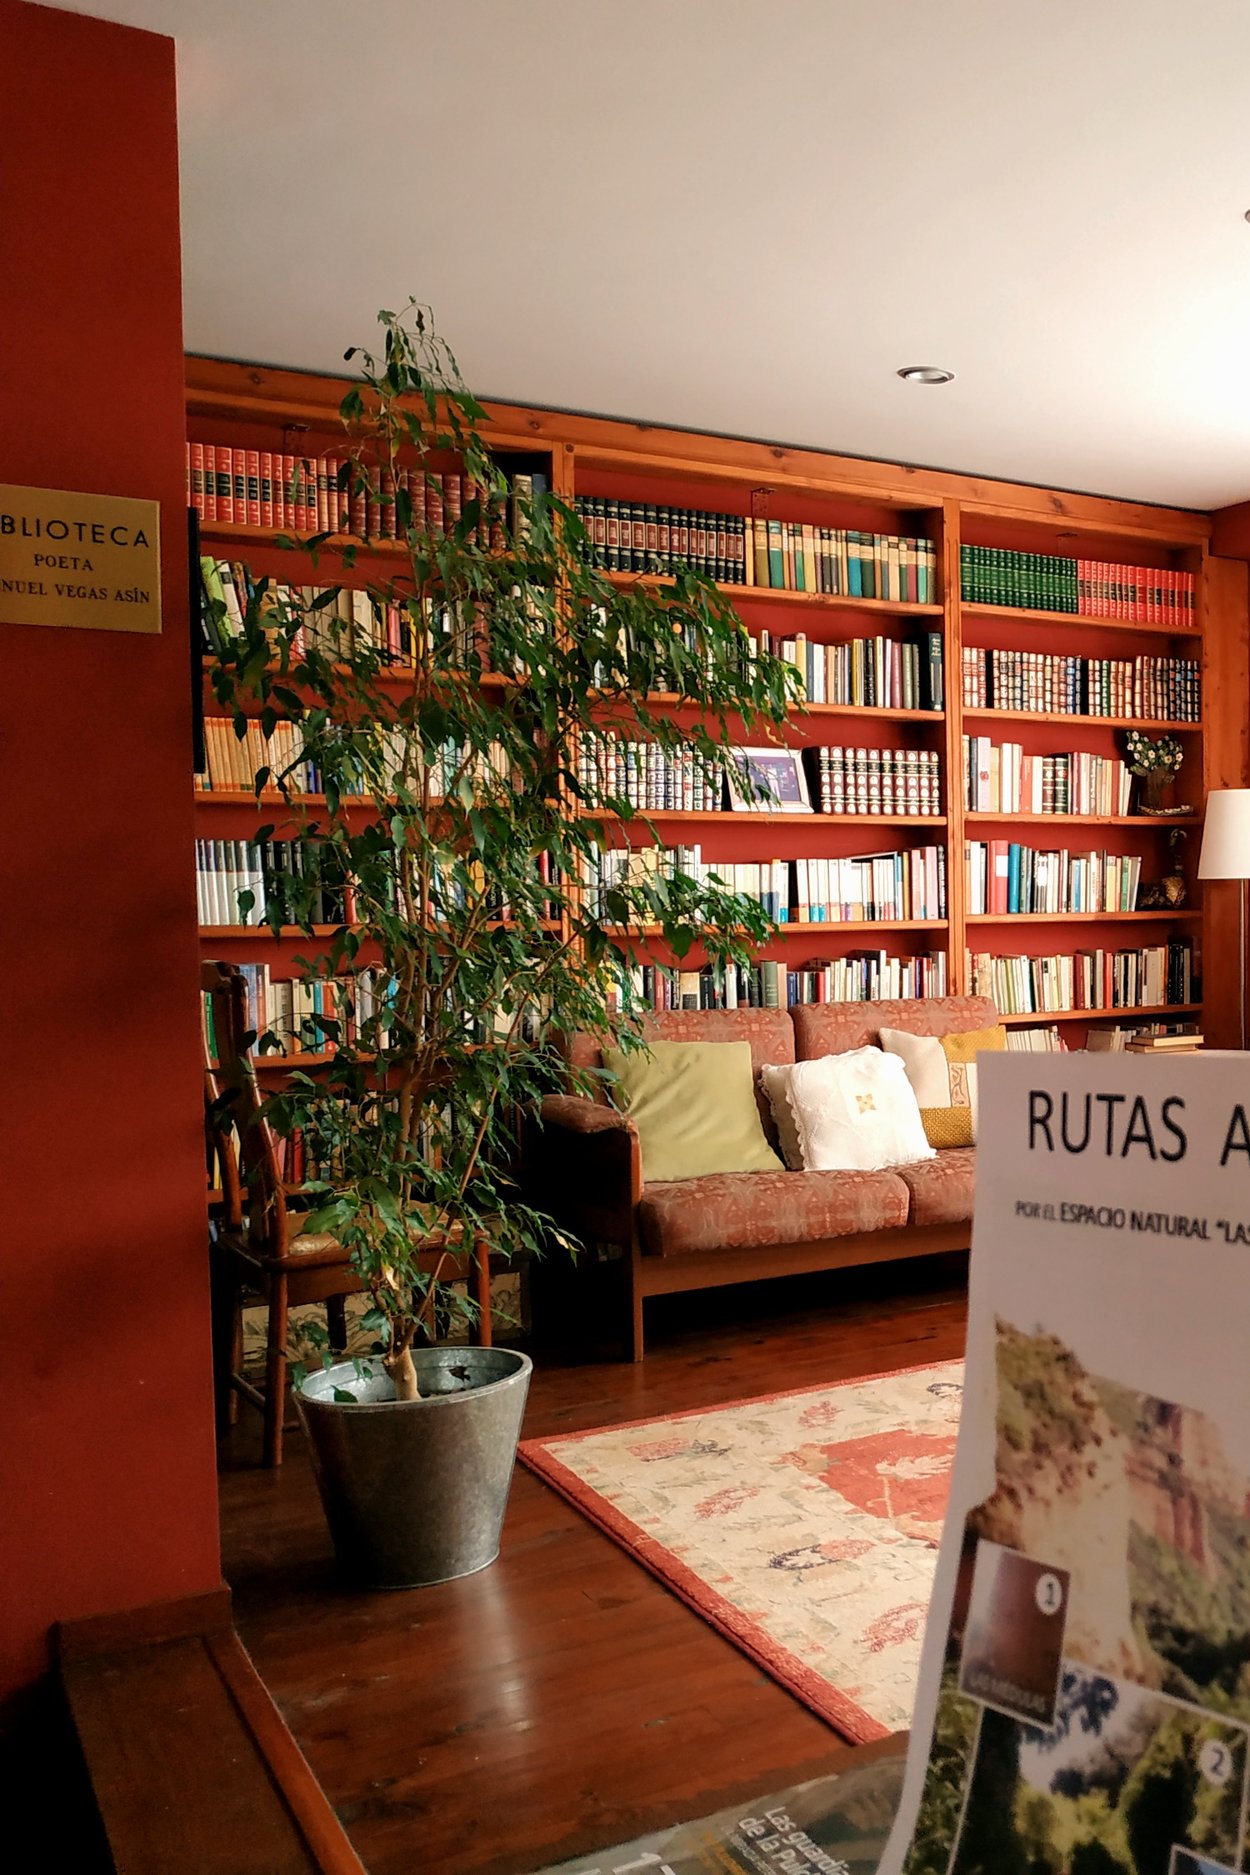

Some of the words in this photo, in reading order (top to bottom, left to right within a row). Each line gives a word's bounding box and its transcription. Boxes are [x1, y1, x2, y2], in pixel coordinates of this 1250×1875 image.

[0, 514, 149, 548] BLIOTECA
[34, 553, 94, 571] POETA
[55, 584, 108, 600] VEGAS
[114, 587, 150, 603] ASÍN
[1028, 1089, 1190, 1163] RUTAS
[1015, 1200, 1041, 1218] POR
[1043, 1203, 1056, 1221] EL
[1059, 1201, 1126, 1229] ESPACIO
[1130, 1209, 1210, 1241] NATURAL
